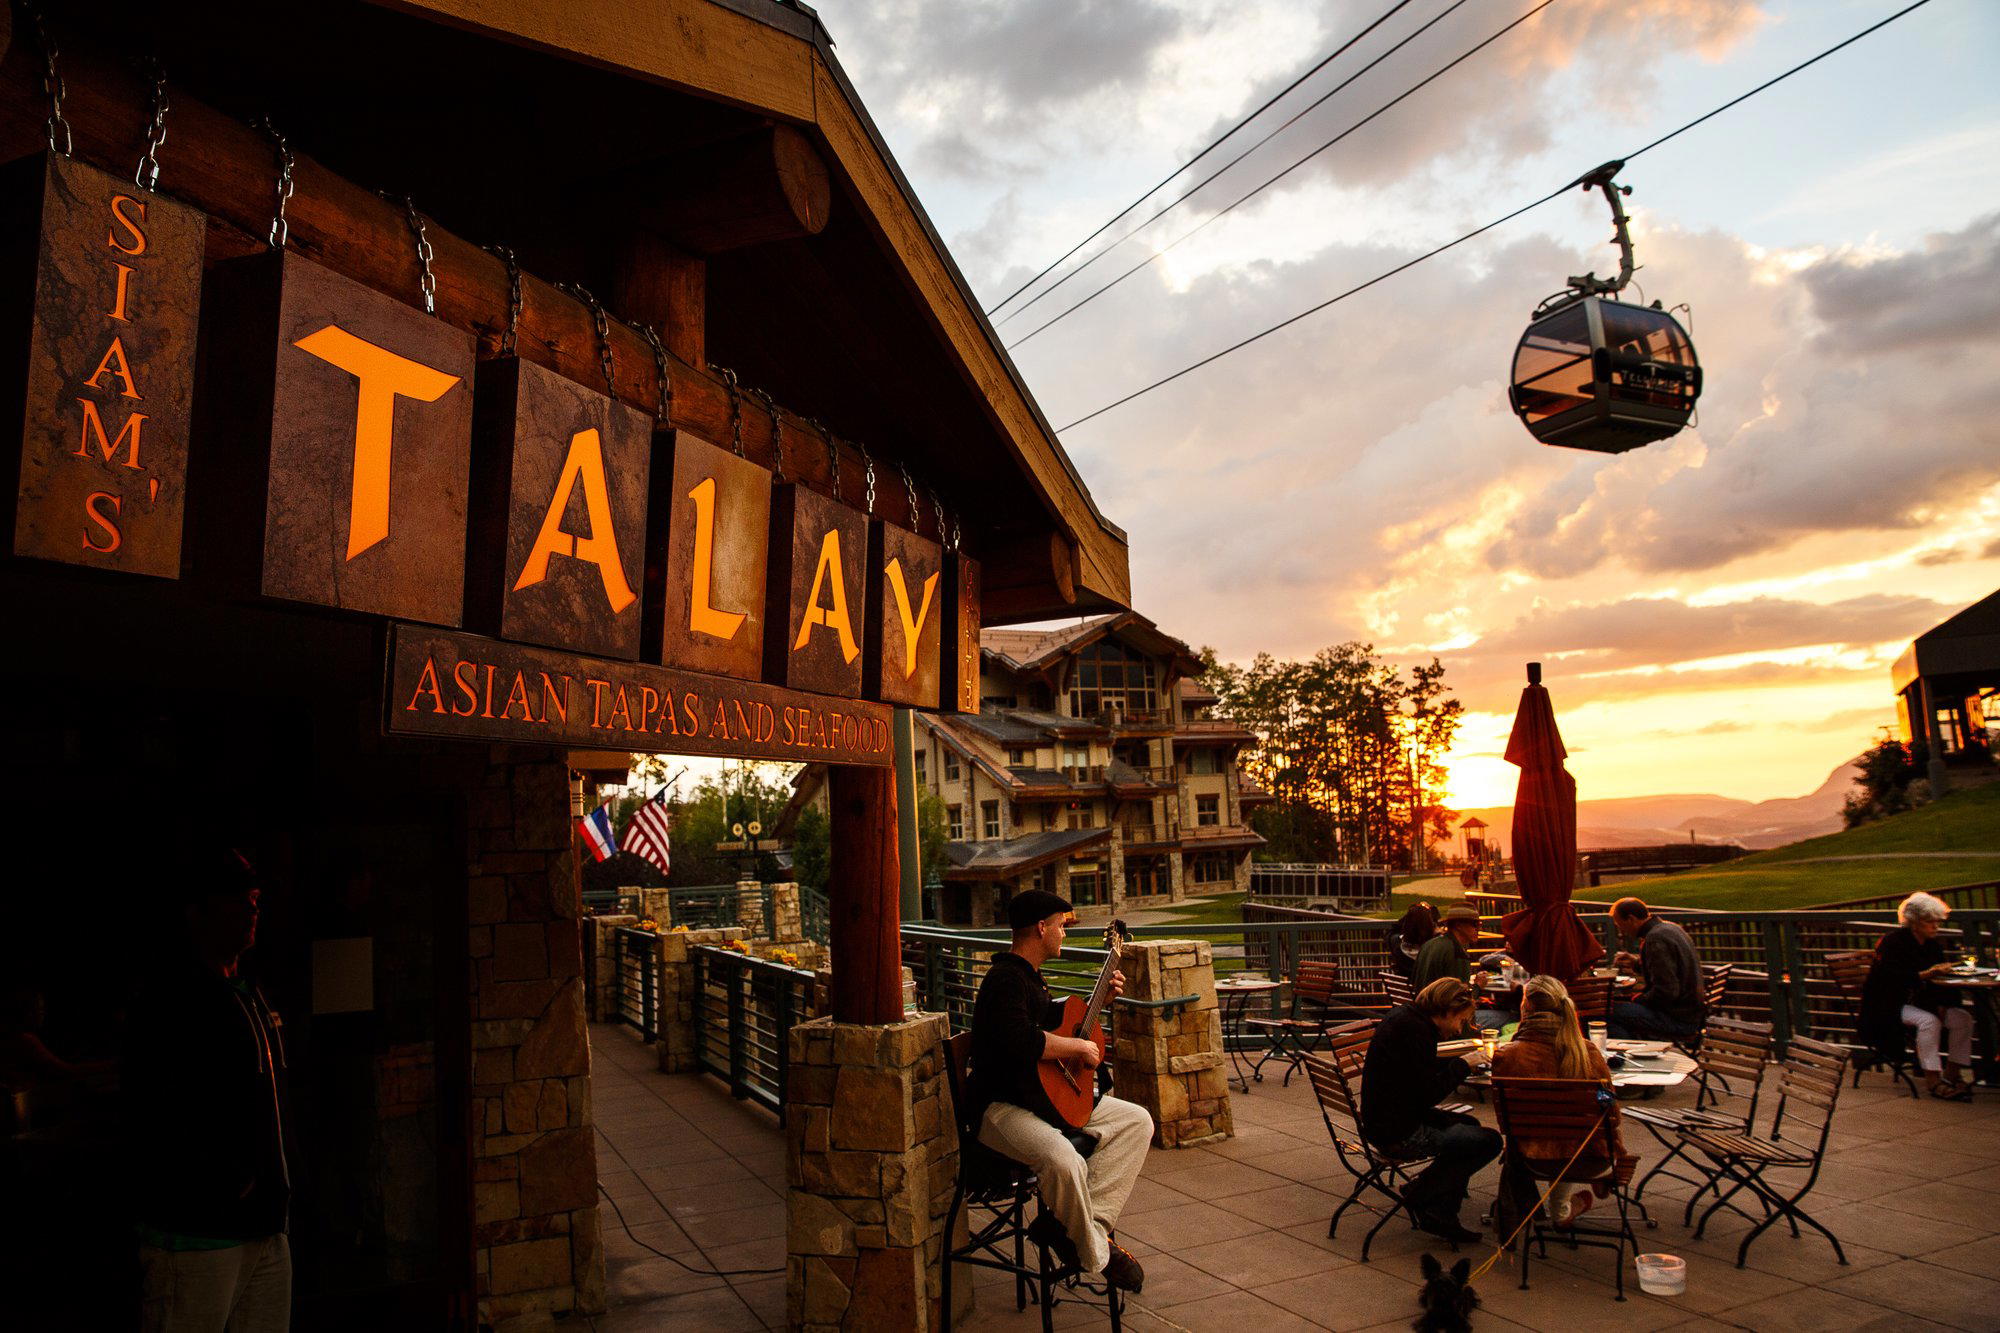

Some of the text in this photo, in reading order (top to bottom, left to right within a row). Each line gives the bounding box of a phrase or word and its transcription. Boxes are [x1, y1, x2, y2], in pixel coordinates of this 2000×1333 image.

[72, 194, 161, 554] SIAM'S
[293, 323, 940, 682] TALAY
[406, 655, 889, 753] ASIAN TAPAS AND SEAFOOD
